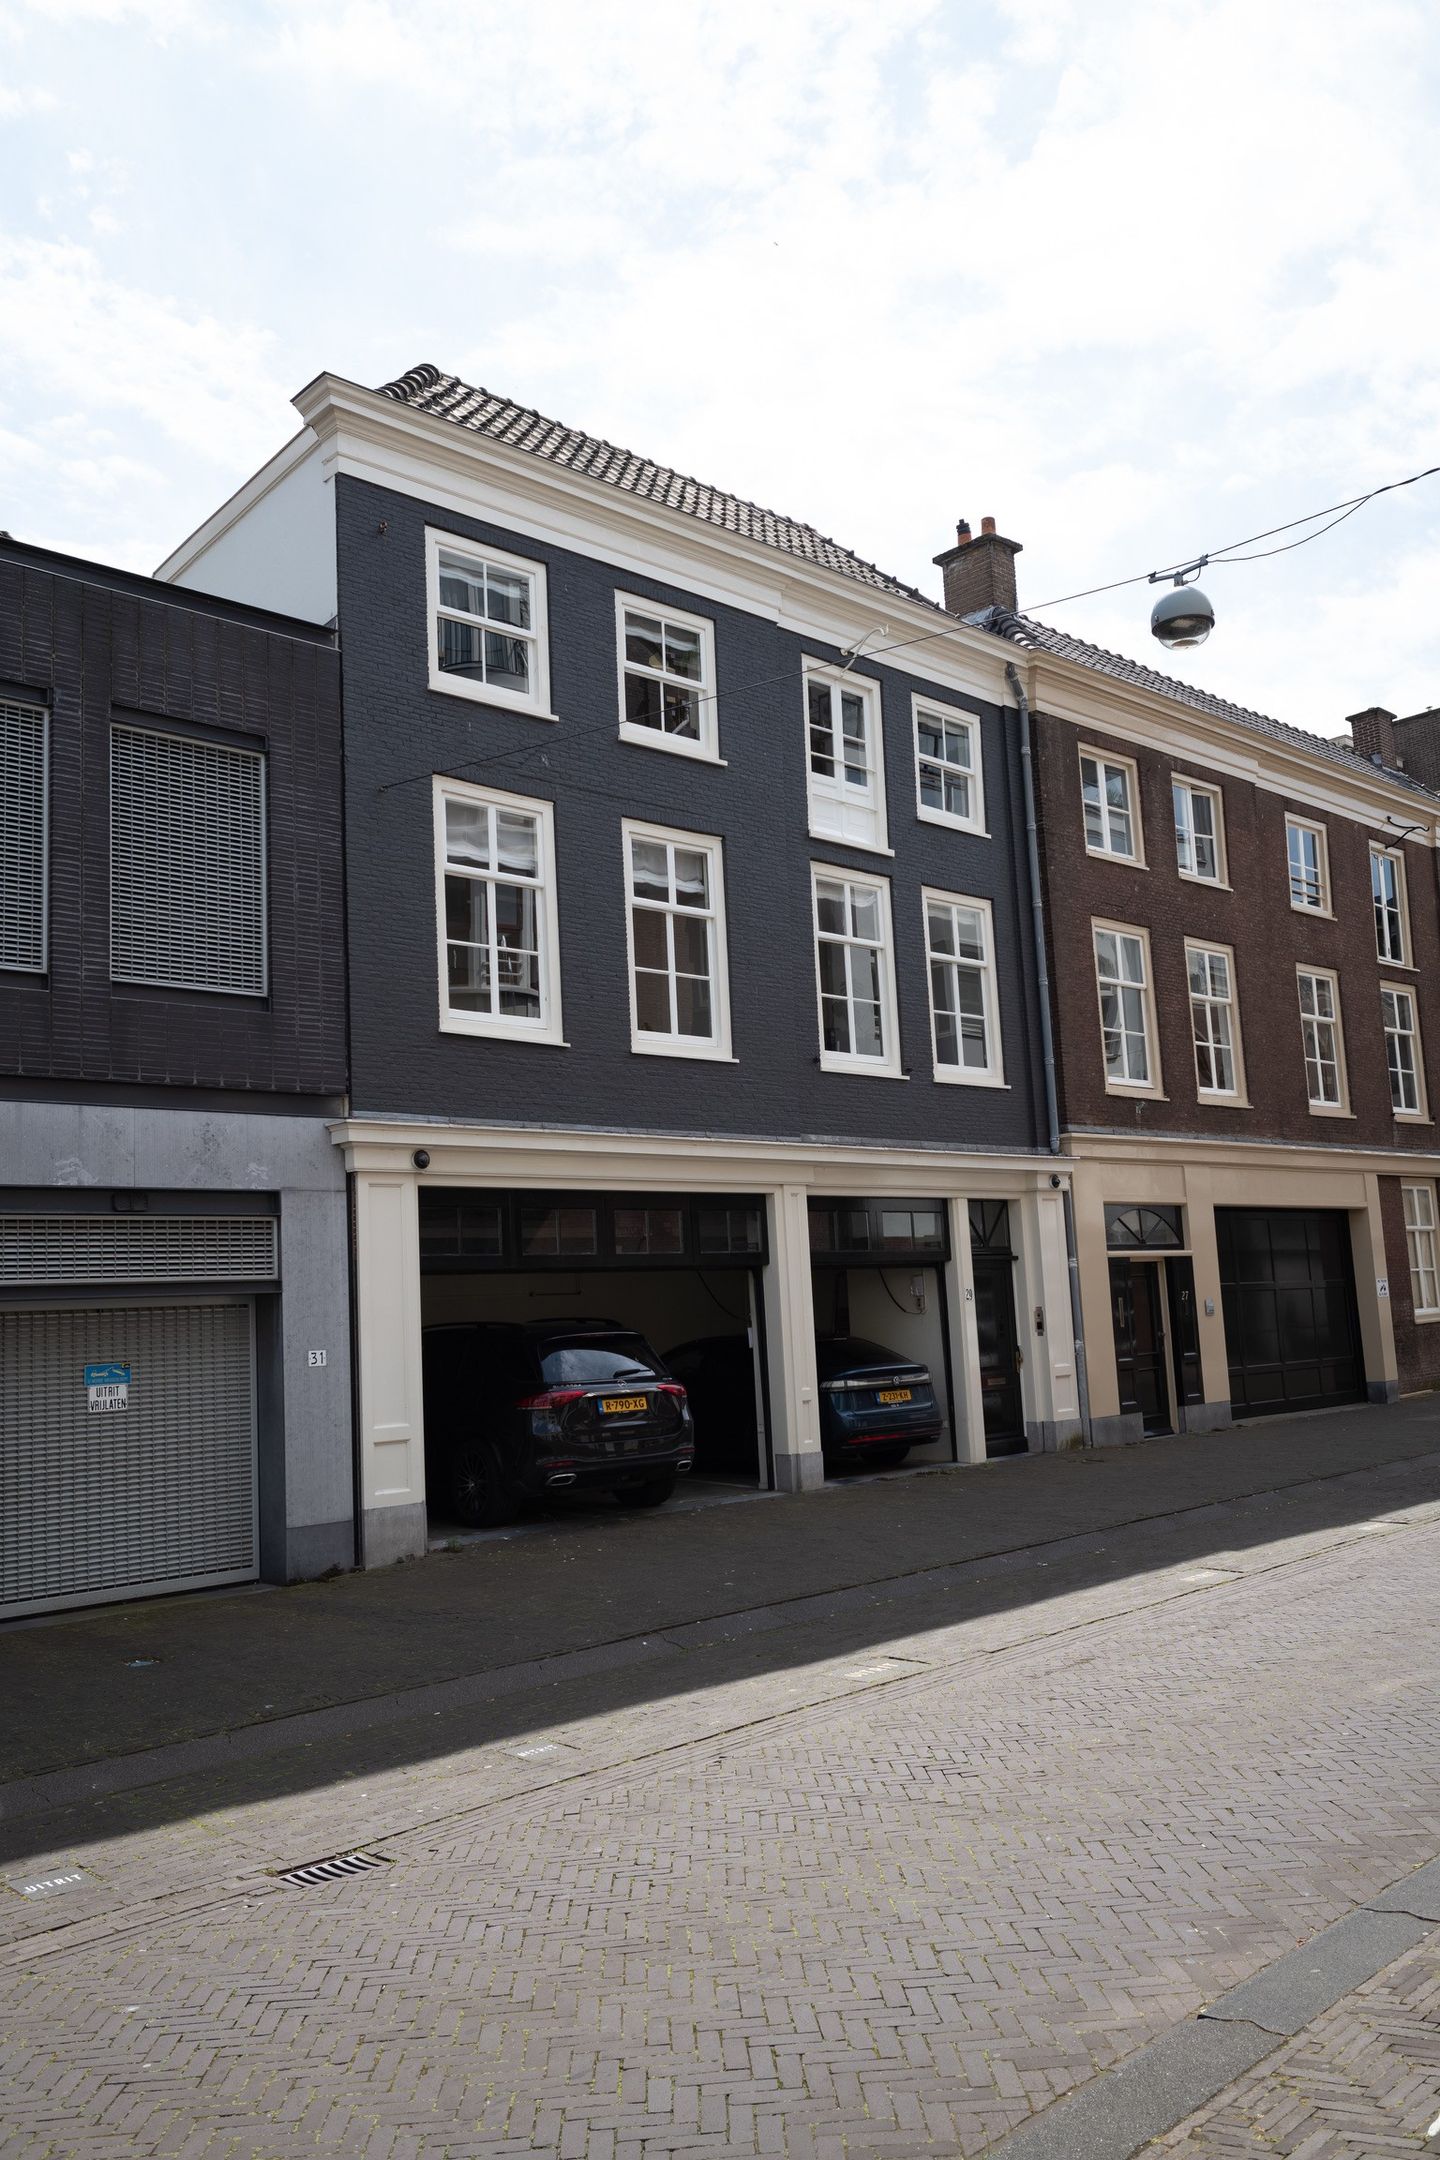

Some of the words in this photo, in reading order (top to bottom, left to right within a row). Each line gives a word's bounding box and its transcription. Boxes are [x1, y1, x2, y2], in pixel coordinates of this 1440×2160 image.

[965, 1288, 973, 1301] 29
[1181, 1290, 1189, 1301] 27
[311, 1352, 324, 1365] 31
[95, 1385, 120, 1398] UITRIT
[90, 1398, 128, 1411] VRIJLATEN
[605, 1398, 645, 1411] R-790-XG
[24, 1873, 82, 1892] UITRIT
